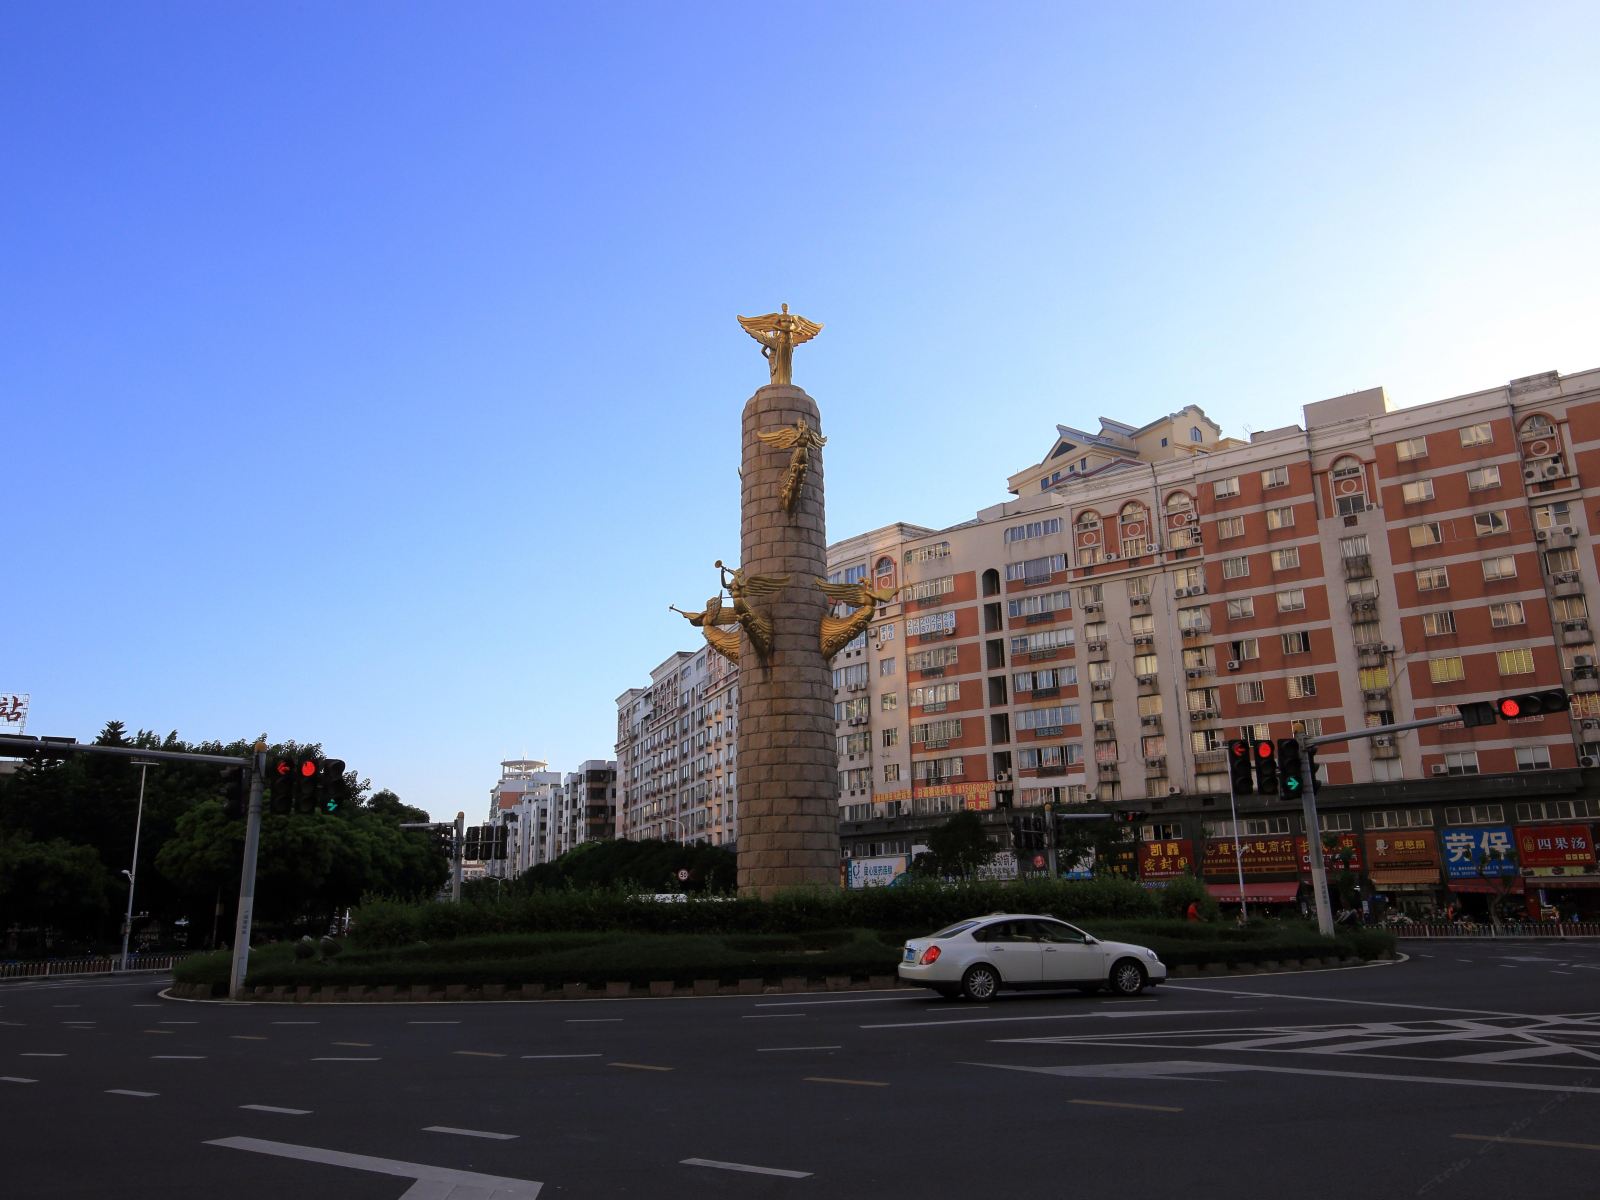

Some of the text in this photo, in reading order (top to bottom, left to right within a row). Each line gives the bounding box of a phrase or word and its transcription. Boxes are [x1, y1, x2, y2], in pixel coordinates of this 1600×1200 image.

[0, 695, 23, 722] 站
[1445, 831, 1511, 863] 劳保
[1537, 836, 1586, 850] 四果汤
